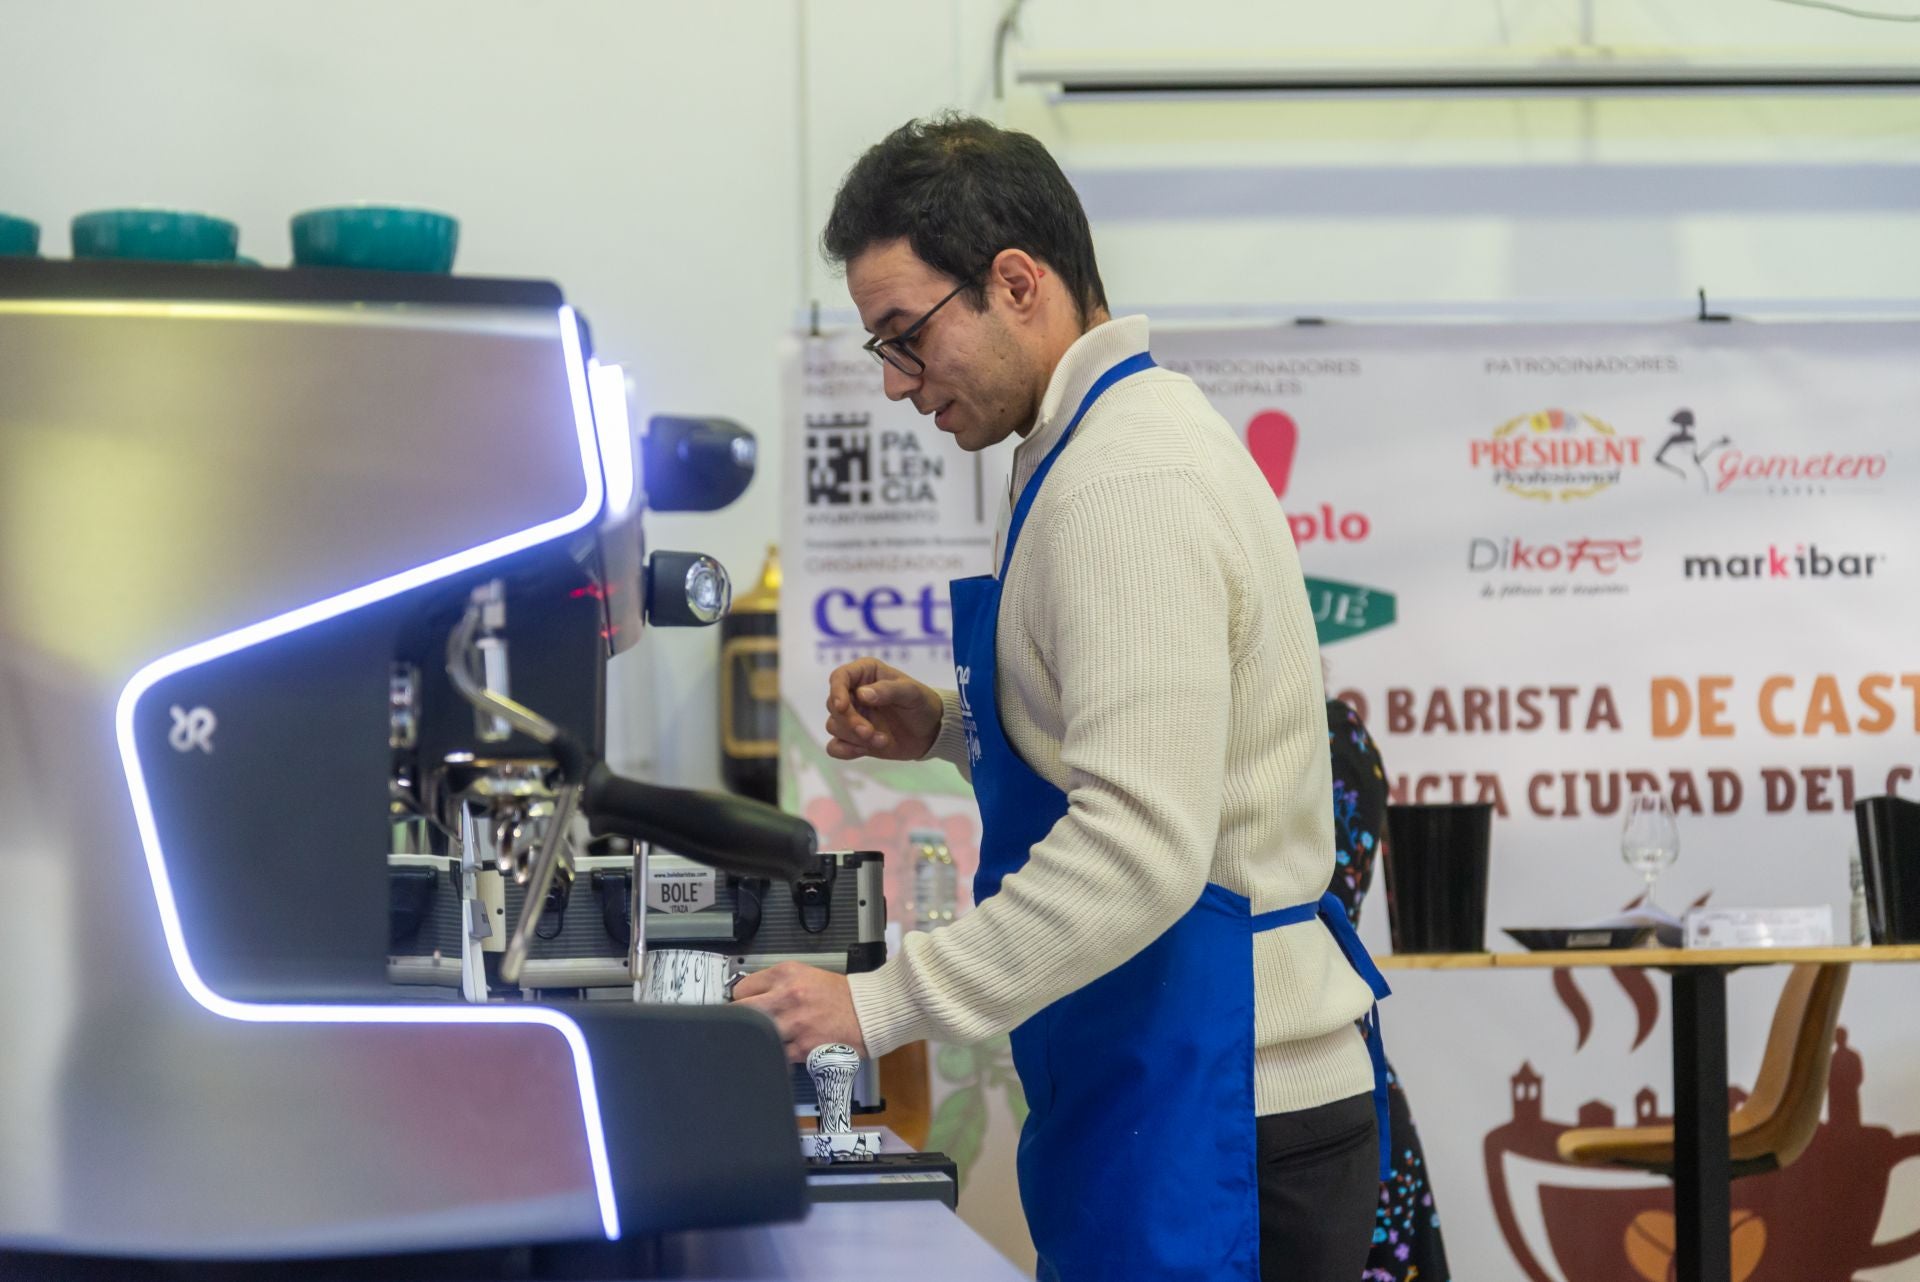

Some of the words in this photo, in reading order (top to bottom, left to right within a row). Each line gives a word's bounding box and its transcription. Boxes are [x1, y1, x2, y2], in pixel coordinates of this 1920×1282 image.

[1484, 356, 1679, 374] PATROCINADORES
[1684, 543, 1877, 579] markibar
[1386, 684, 1623, 735] BARISTA
[1651, 673, 1736, 740] DE
